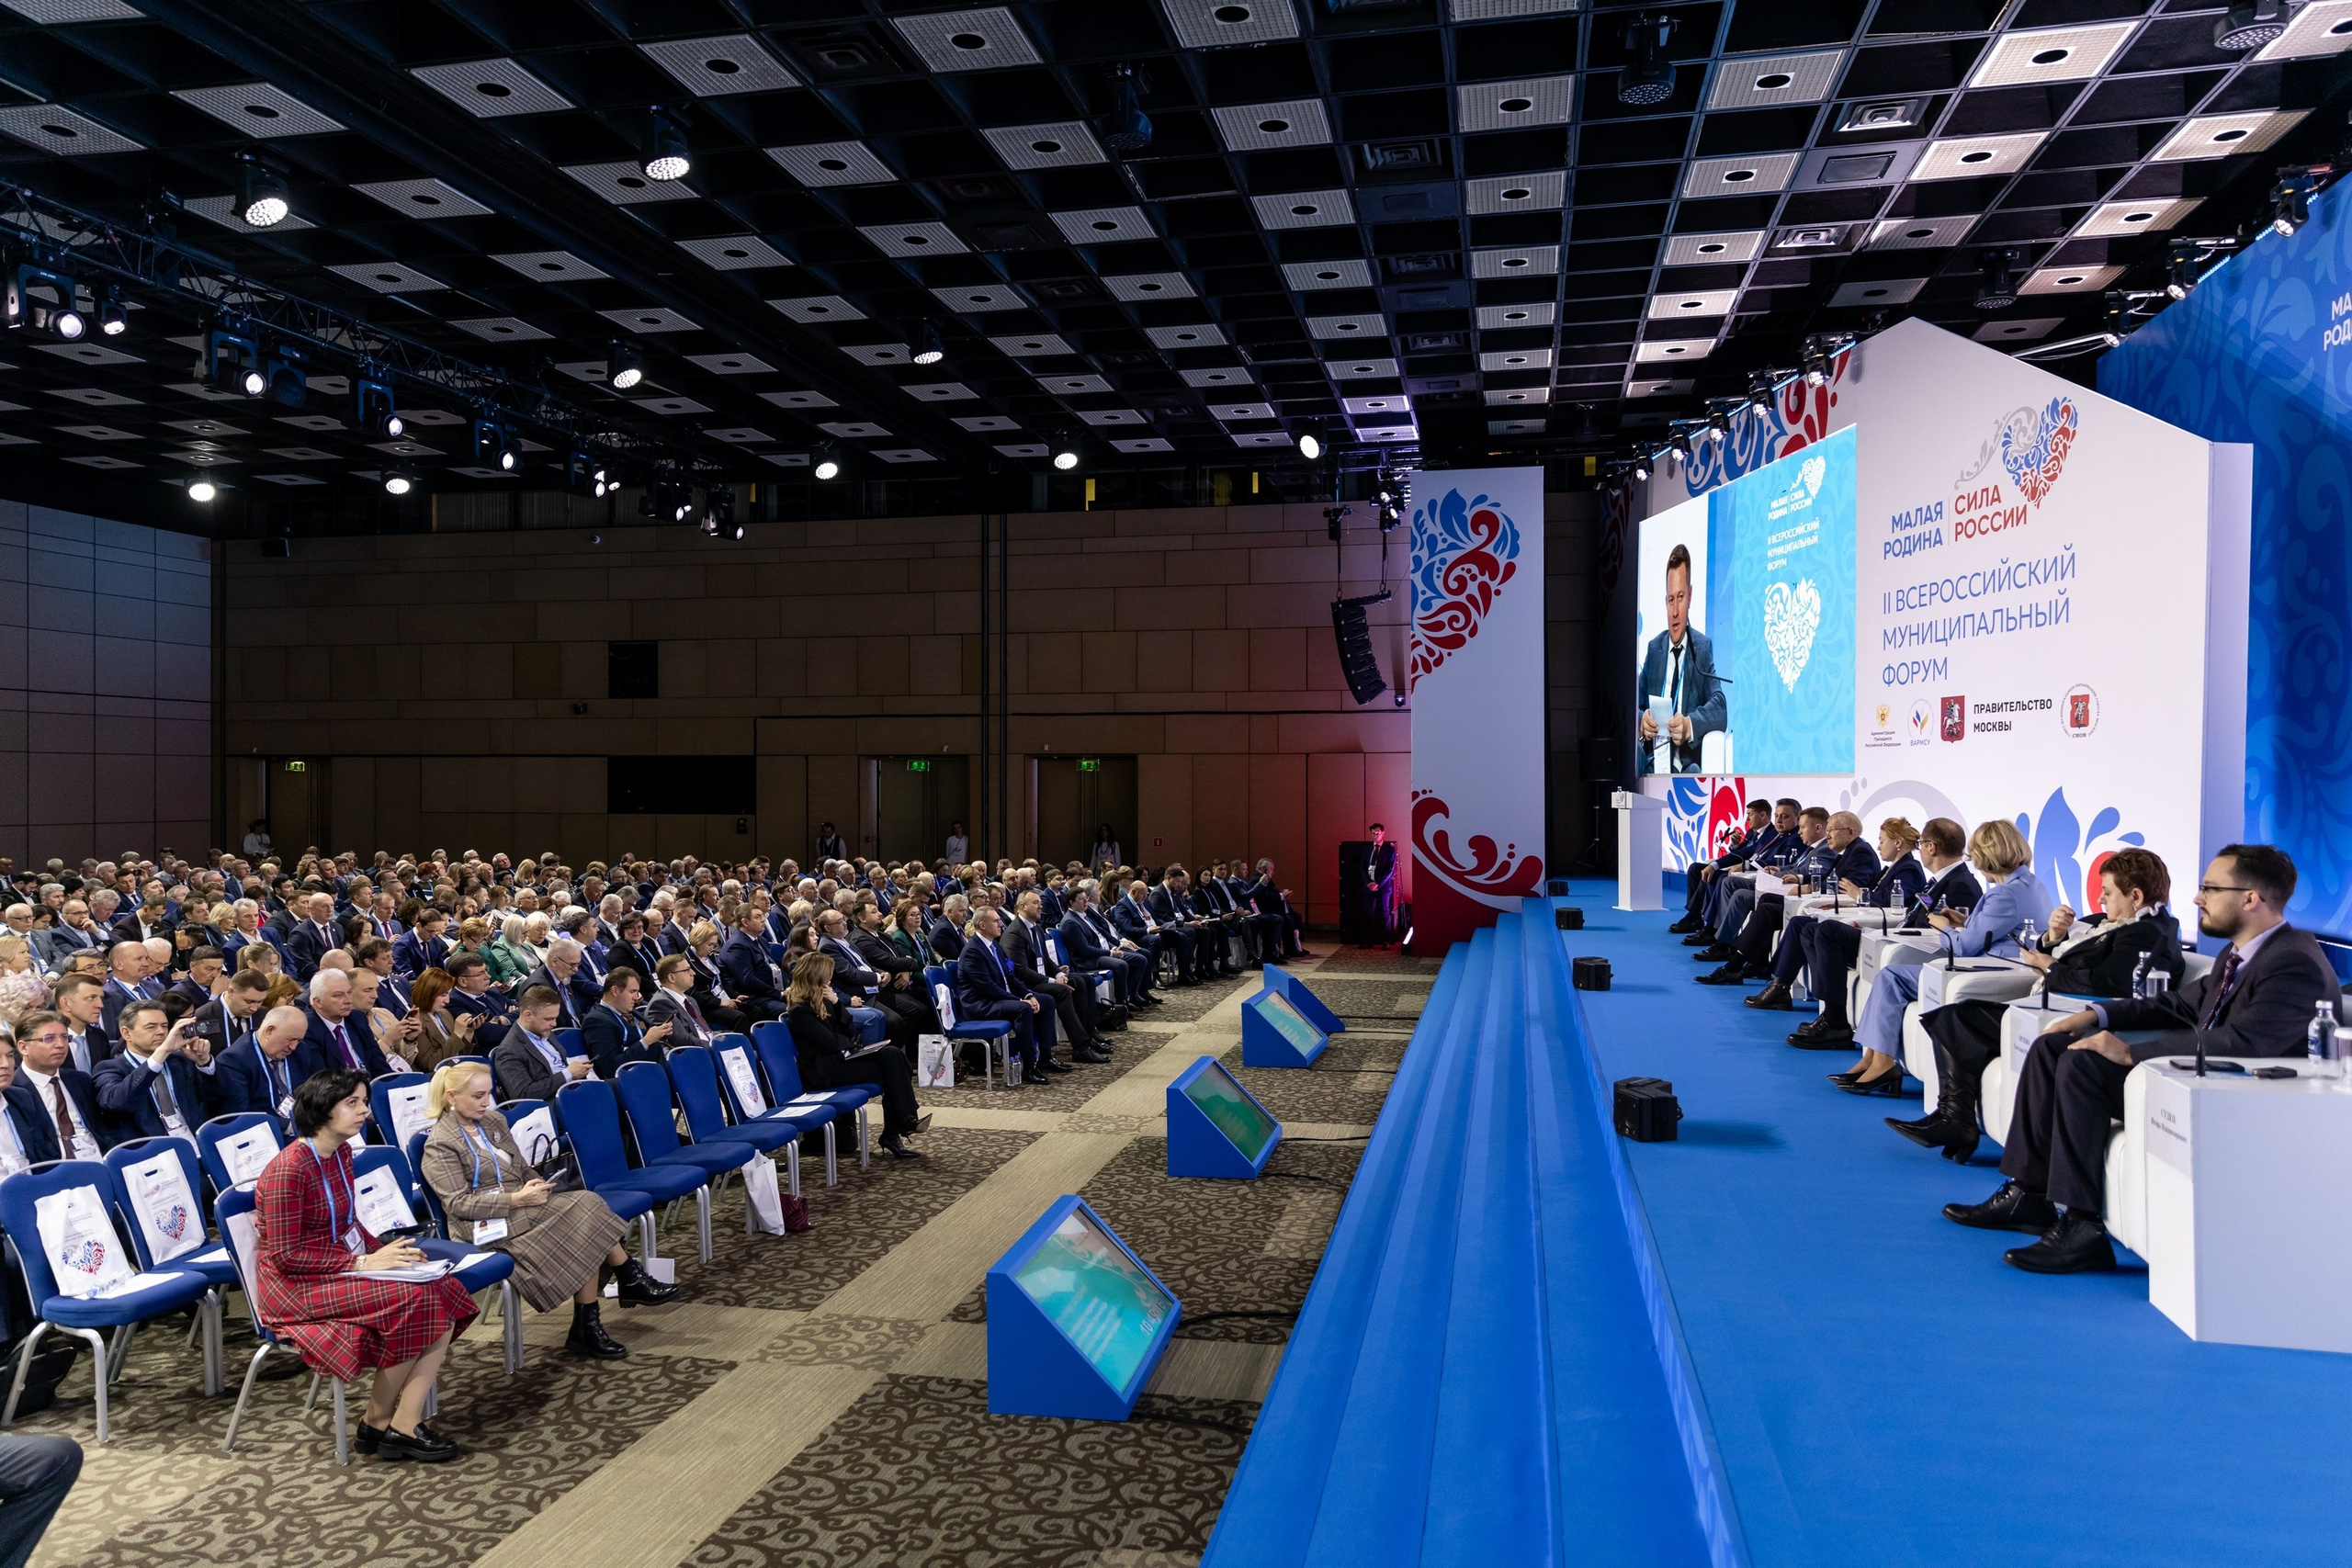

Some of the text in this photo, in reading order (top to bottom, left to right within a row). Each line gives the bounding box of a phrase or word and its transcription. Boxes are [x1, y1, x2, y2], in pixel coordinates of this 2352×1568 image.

[2332, 292, 2352, 321] МА
[2324, 318, 2352, 351] РОД
[1768, 506, 1788, 521] РОДИНА
[1790, 497, 1813, 513] РОССИИ
[1955, 484, 2001, 514] СИЛА
[1771, 516, 1820, 544] ВСЕРОССИЙСКИЙ
[1892, 501, 1943, 534] МАЛАЯ
[1955, 503, 2028, 542] РОССИИ
[1767, 531, 1818, 558] МУНИЦИПАЛЬНЫЙ
[1883, 527, 1943, 560] РОДИНА
[1767, 558, 1787, 571] ФОРУМ
[1883, 543, 2075, 615] II ВСЕРОССИЙСКИЙ
[1883, 588, 2069, 651] МУНИЦИПАЛЬНЫЙ
[1883, 657, 1948, 687] ФОРУМ
[1973, 698, 2052, 715] ПРАВИТЕЛЬСТВО
[1973, 720, 2012, 733] МОСКВЫ
